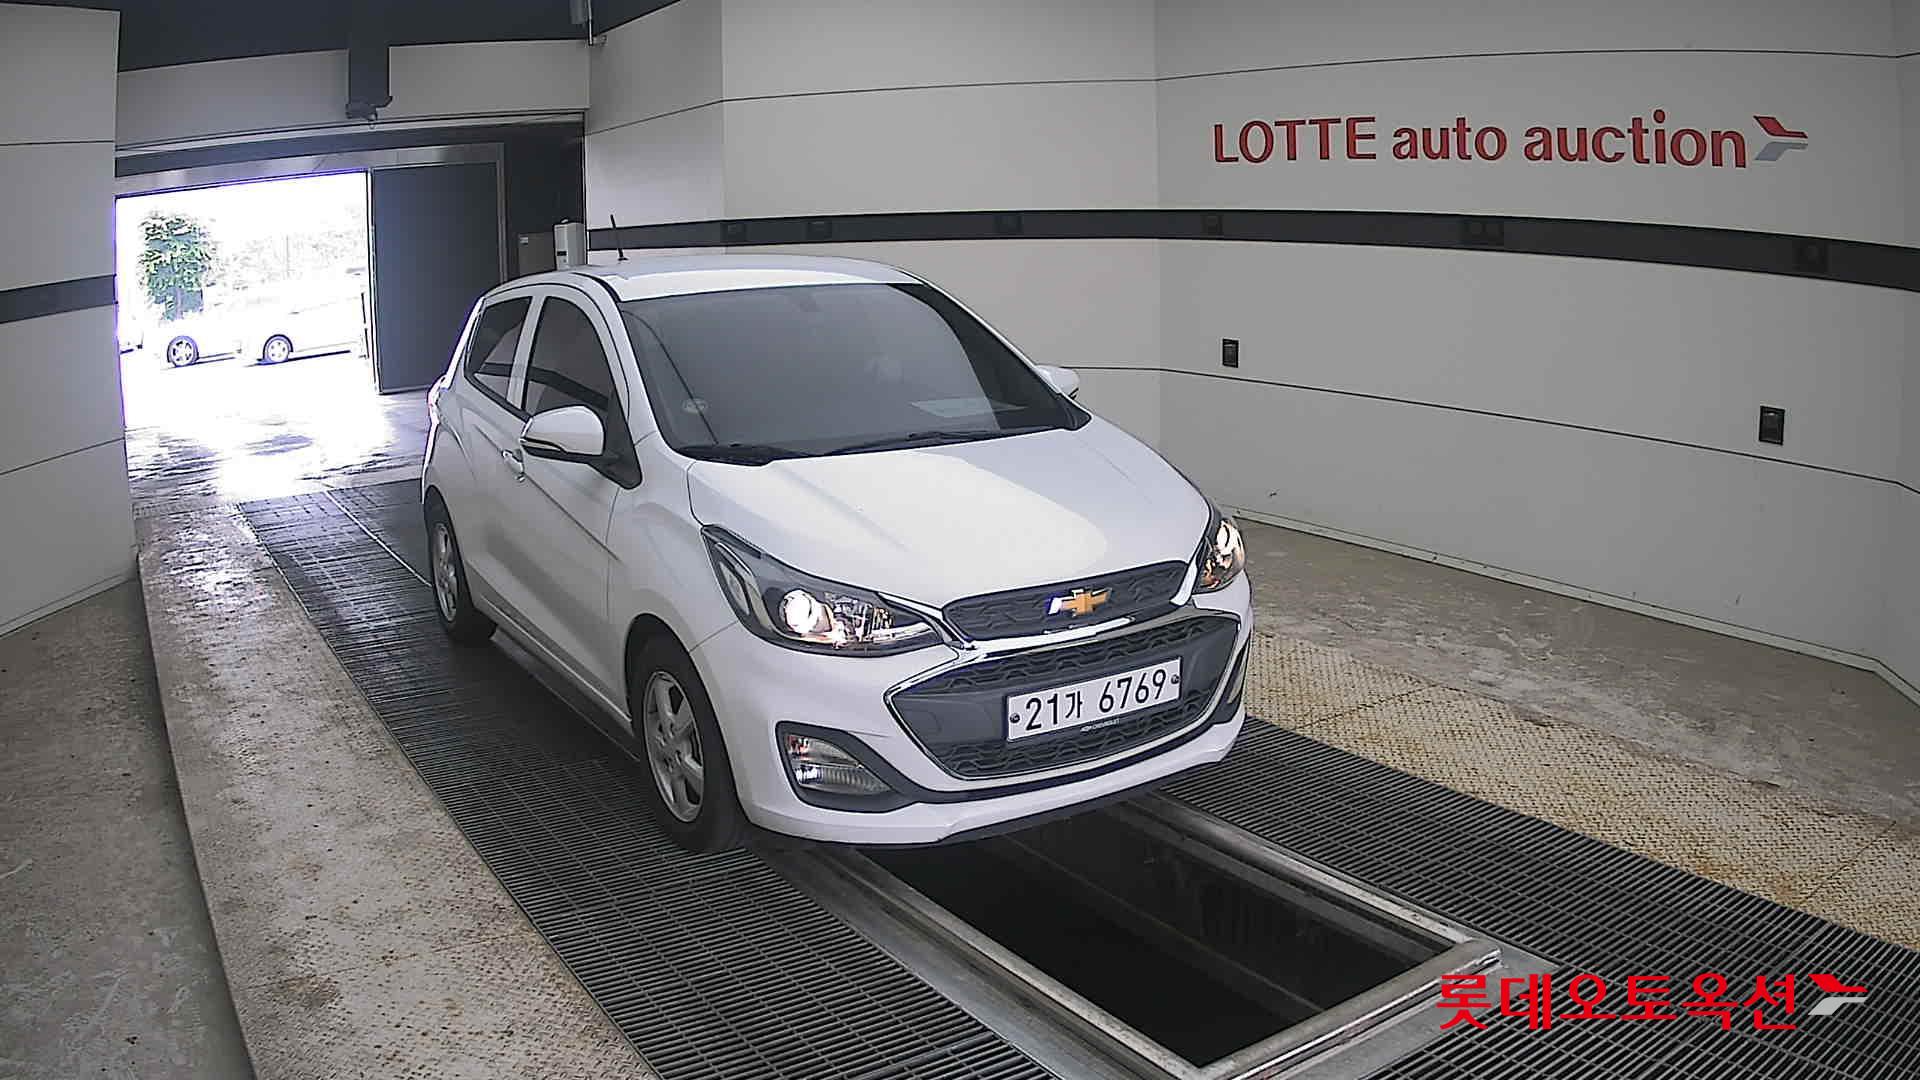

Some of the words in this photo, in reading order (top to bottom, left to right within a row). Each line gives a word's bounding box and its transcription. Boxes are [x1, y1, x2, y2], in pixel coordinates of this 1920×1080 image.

[1215, 117, 1376, 162] LOTTE
[1392, 117, 1508, 161] auto
[1524, 110, 1747, 168] auction
[1025, 691, 1083, 731] 21가
[1099, 668, 1167, 714] 6769
